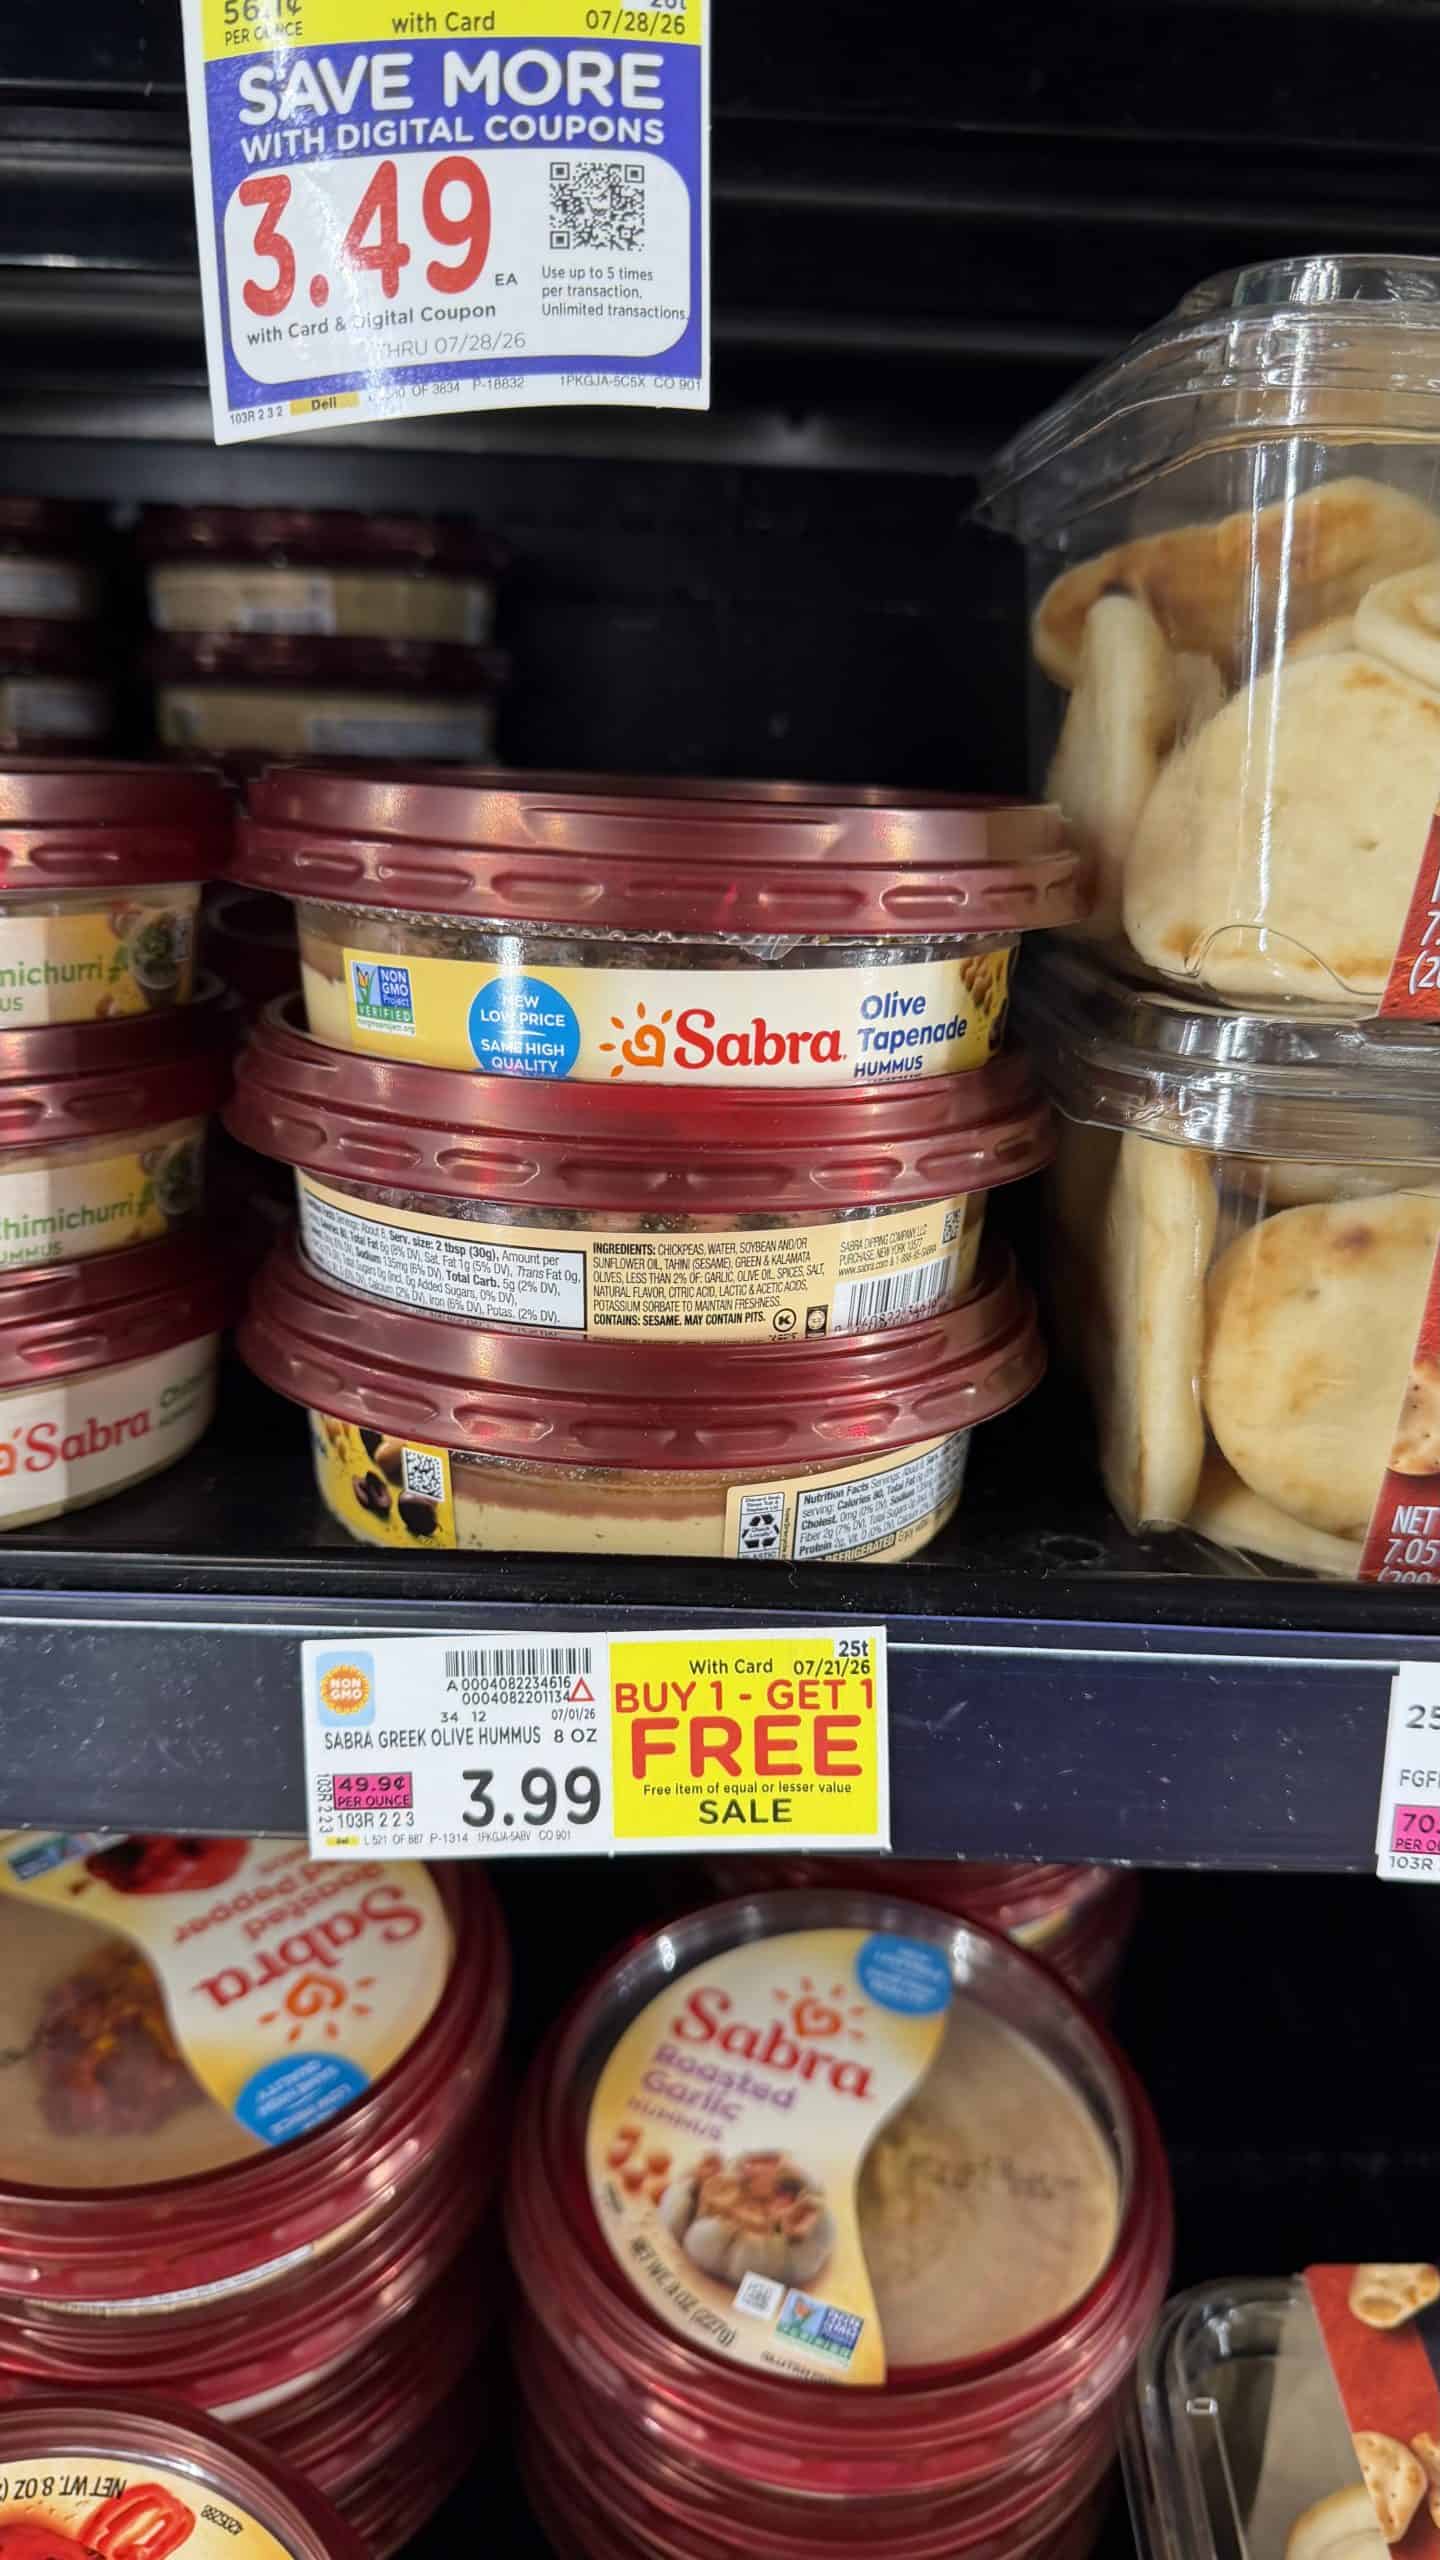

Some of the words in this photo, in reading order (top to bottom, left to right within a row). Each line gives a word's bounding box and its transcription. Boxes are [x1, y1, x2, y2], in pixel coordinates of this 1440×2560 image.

[392, 14, 437, 33] with
[445, 11, 496, 31] Card
[585, 9, 687, 36] 07/28/26
[225, 28, 250, 46] PER
[238, 53, 414, 126] SAVE
[443, 49, 665, 110] MORE
[240, 126, 325, 163] WITH
[337, 116, 475, 151] DIGITAL
[485, 115, 665, 145] COUPONS
[238, 155, 491, 318] 3.49
[495, 273, 519, 286] EA
[541, 265, 566, 280] Use
[569, 267, 586, 285] up
[589, 266, 604, 281] to
[606, 266, 615, 280] 5
[618, 266, 654, 282] times
[541, 286, 563, 301] per
[566, 284, 644, 300] transaction.
[541, 302, 604, 318] Unlimited
[247, 326, 283, 346] with
[288, 318, 330, 339] Card
[335, 316, 347, 332] &
[421, 304, 496, 323] Coupon
[434, 329, 527, 355] 07/28/26
[311, 396, 337, 411] Deli
[228, 411, 256, 426] 103R
[258, 409, 265, 421] 2
[267, 407, 275, 419] 3
[276, 406, 283, 417] 2
[380, 969, 408, 984] NON
[382, 981, 409, 997] GMO
[860, 989, 926, 1020] Olive
[520, 1012, 566, 1028] PRICE
[673, 1007, 843, 1070] Sabra
[856, 1014, 968, 1054] Tapenade
[480, 1038, 523, 1055] SAME
[526, 1042, 565, 1057] HIGH
[491, 1056, 558, 1073] QUALITY
[853, 1055, 923, 1078] HUMMUS
[0, 1192, 135, 1239] himichurri
[435, 1239, 442, 1252] 2
[444, 1241, 466, 1257] tbsp
[501, 1250, 541, 1265] Amount
[542, 1255, 560, 1267] per
[592, 1242, 656, 1256] INGREDIENTS:
[739, 1240, 777, 1254] SOYBEAN
[592, 1256, 645, 1270] SUNFLOWER
[446, 1270, 470, 1284] Total
[472, 1275, 500, 1289] Carb.
[546, 1269, 562, 1281] Fat
[626, 1272, 647, 1284] LESS
[648, 1272, 672, 1284] THAN
[593, 1313, 641, 1326] CONTAINS:
[683, 1314, 704, 1326] MAY
[705, 1313, 743, 1326] CONTAIN
[744, 1310, 766, 1322] PITS.
[23, 1408, 153, 1472] Sabra
[803, 1488, 845, 1505] Nutrition
[1391, 1504, 1440, 1536] NET
[1383, 1537, 1440, 1567] 7.05
[838, 1640, 869, 1657] 25t
[689, 1658, 728, 1675] With
[734, 1657, 774, 1674] Card
[793, 1658, 871, 1678] 07/21/26
[330, 1678, 362, 1690] NON
[447, 1679, 459, 1691] A
[461, 1676, 571, 1692] 0004082234616
[329, 1689, 363, 1700] GMO
[462, 1690, 571, 1705] 0004082201134
[615, 1681, 697, 1714] BUY
[710, 1680, 724, 1711] 1
[739, 1692, 753, 1701] -
[766, 1679, 847, 1711] GET
[860, 1677, 873, 1710] 1
[440, 1711, 459, 1723] 34
[472, 1710, 487, 1722] 12
[551, 1707, 596, 1721] 07/01/26
[324, 1730, 374, 1750] SABRA
[378, 1729, 427, 1747] GREEK
[431, 1727, 474, 1746] OLIVE
[478, 1725, 542, 1745] HUMMUS
[554, 1729, 564, 1744] 8
[571, 1728, 598, 1743] OZ
[631, 1714, 863, 1780] FREE
[316, 1773, 333, 1802] 103R
[338, 1775, 406, 1792] 49.9¢
[643, 1783, 671, 1796] Free
[675, 1782, 703, 1795] item
[707, 1781, 720, 1795] of
[723, 1780, 758, 1797] equal
[761, 1782, 775, 1794] or
[778, 1781, 814, 1794] lesser
[818, 1780, 852, 1794] value
[1399, 1768, 1440, 1789] FGF
[337, 1796, 362, 1807] PER
[365, 1794, 410, 1806] OUNCE
[461, 1766, 601, 1828] 3.99
[337, 1812, 375, 1828] 103R
[379, 1812, 389, 1828] 2
[392, 1811, 401, 1827] 2
[406, 1811, 415, 1827] 3
[698, 1798, 793, 1825] SALE
[429, 1831, 469, 1844] P-1314
[1395, 1838, 1423, 1851] PER
[1390, 1855, 1434, 1871] 103R
[191, 1884, 423, 2010] Sabra
[671, 1986, 873, 2102] Sabra
[655, 2043, 798, 2109] Roasted
[642, 2067, 742, 2121] Garlic
[14, 2479, 38, 2500] OZ
[42, 2477, 53, 2496] 8
[59, 2475, 88, 2497] WT.
[87, 2478, 128, 2499] NET
